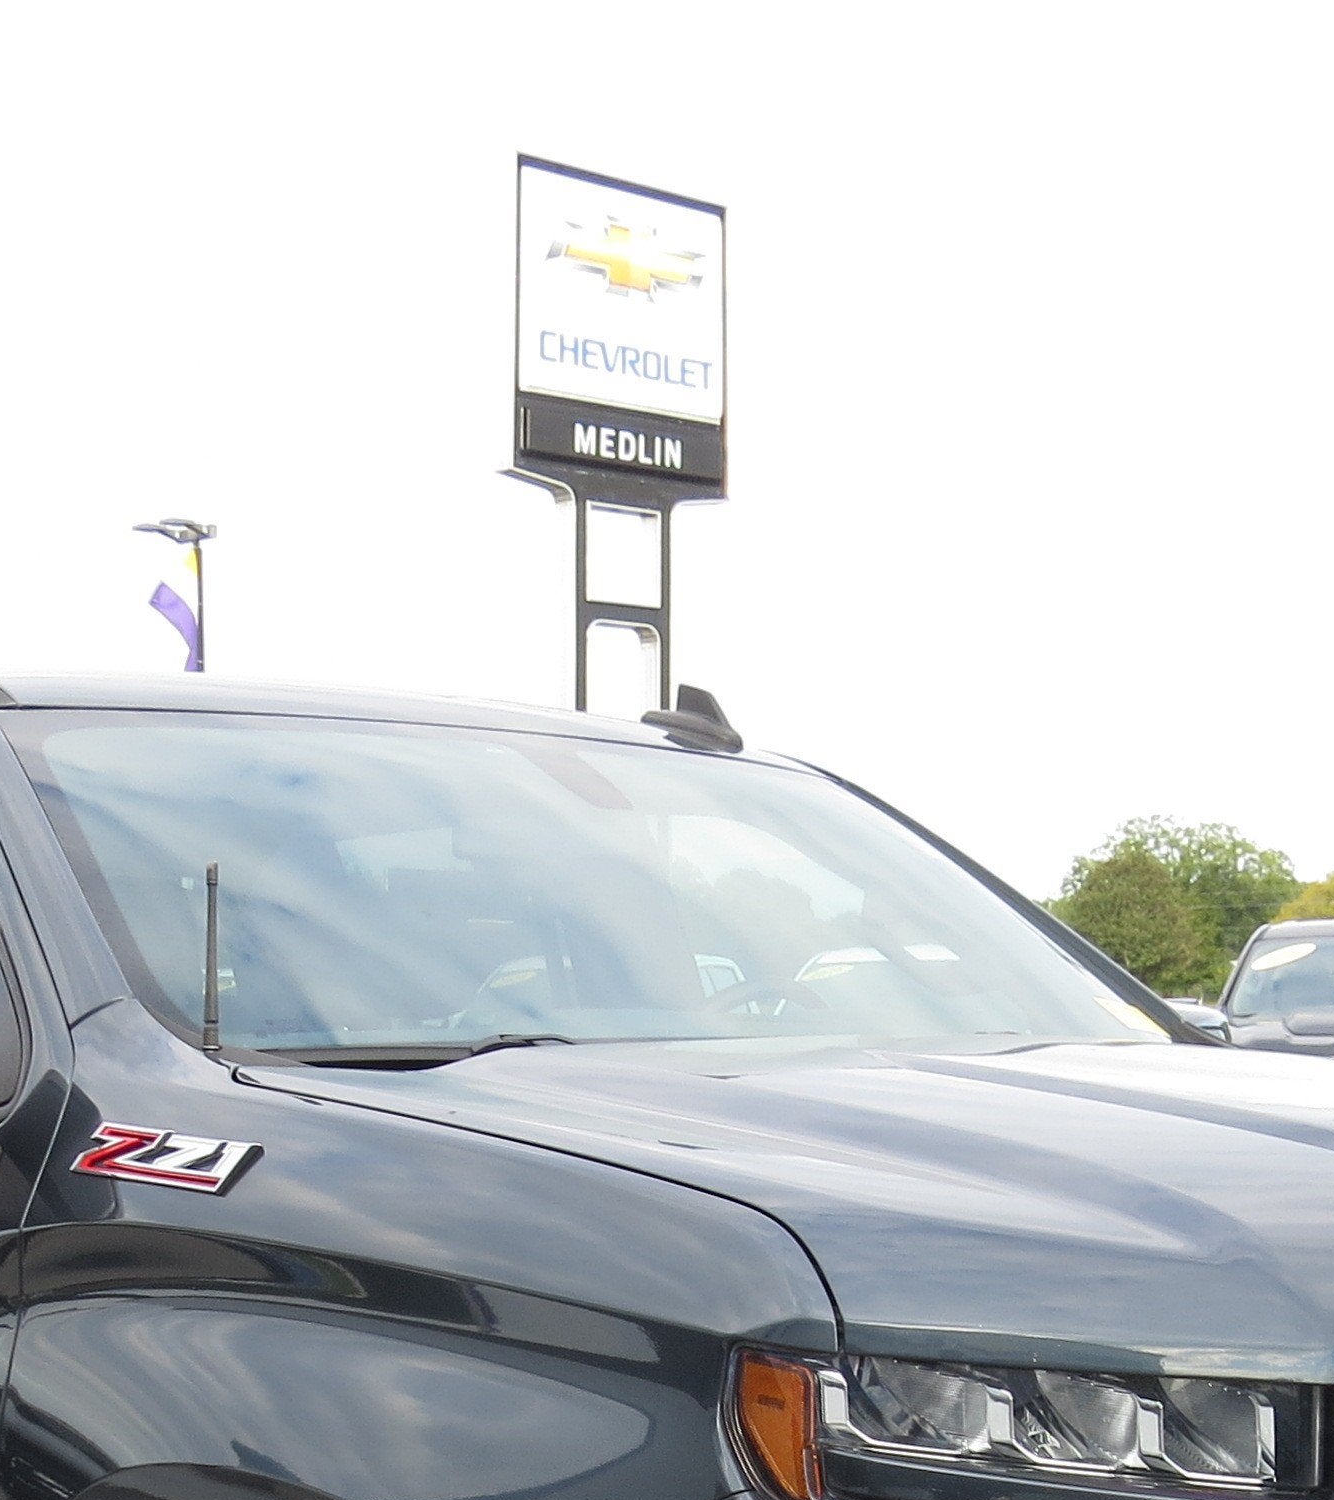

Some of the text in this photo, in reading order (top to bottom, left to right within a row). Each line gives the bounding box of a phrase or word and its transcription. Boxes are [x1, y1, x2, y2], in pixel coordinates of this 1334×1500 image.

[539, 330, 713, 389] CHEVROLET
[573, 422, 684, 470] MEDLIN
[69, 1121, 265, 1197] Z71
